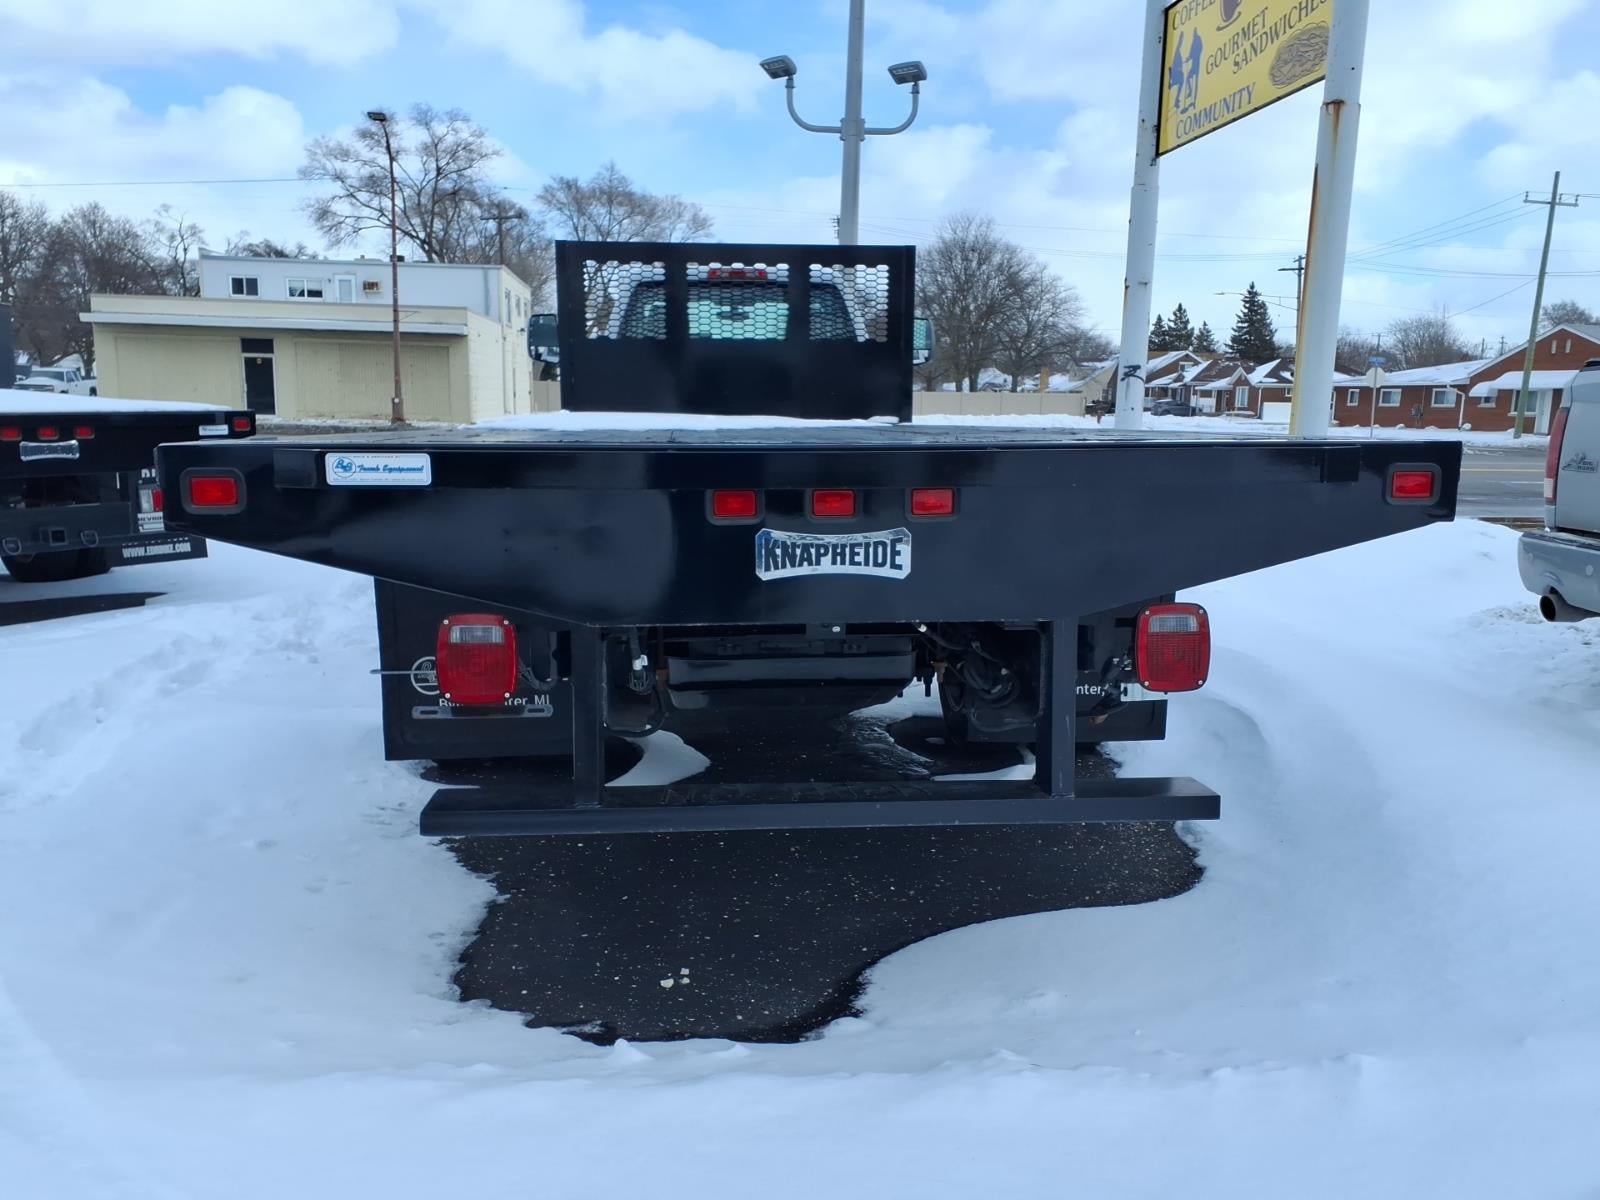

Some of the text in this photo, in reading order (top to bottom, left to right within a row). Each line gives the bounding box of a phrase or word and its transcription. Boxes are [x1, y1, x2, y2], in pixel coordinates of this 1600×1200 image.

[1172, 0, 1216, 31] COFFE
[1232, 0, 1328, 74] SANDWICHE
[1206, 6, 1269, 75] GOURMET
[1175, 81, 1257, 139] COMMUNITY
[382, 464, 425, 474] Equipment
[763, 536, 904, 572] KNAPHEIDE
